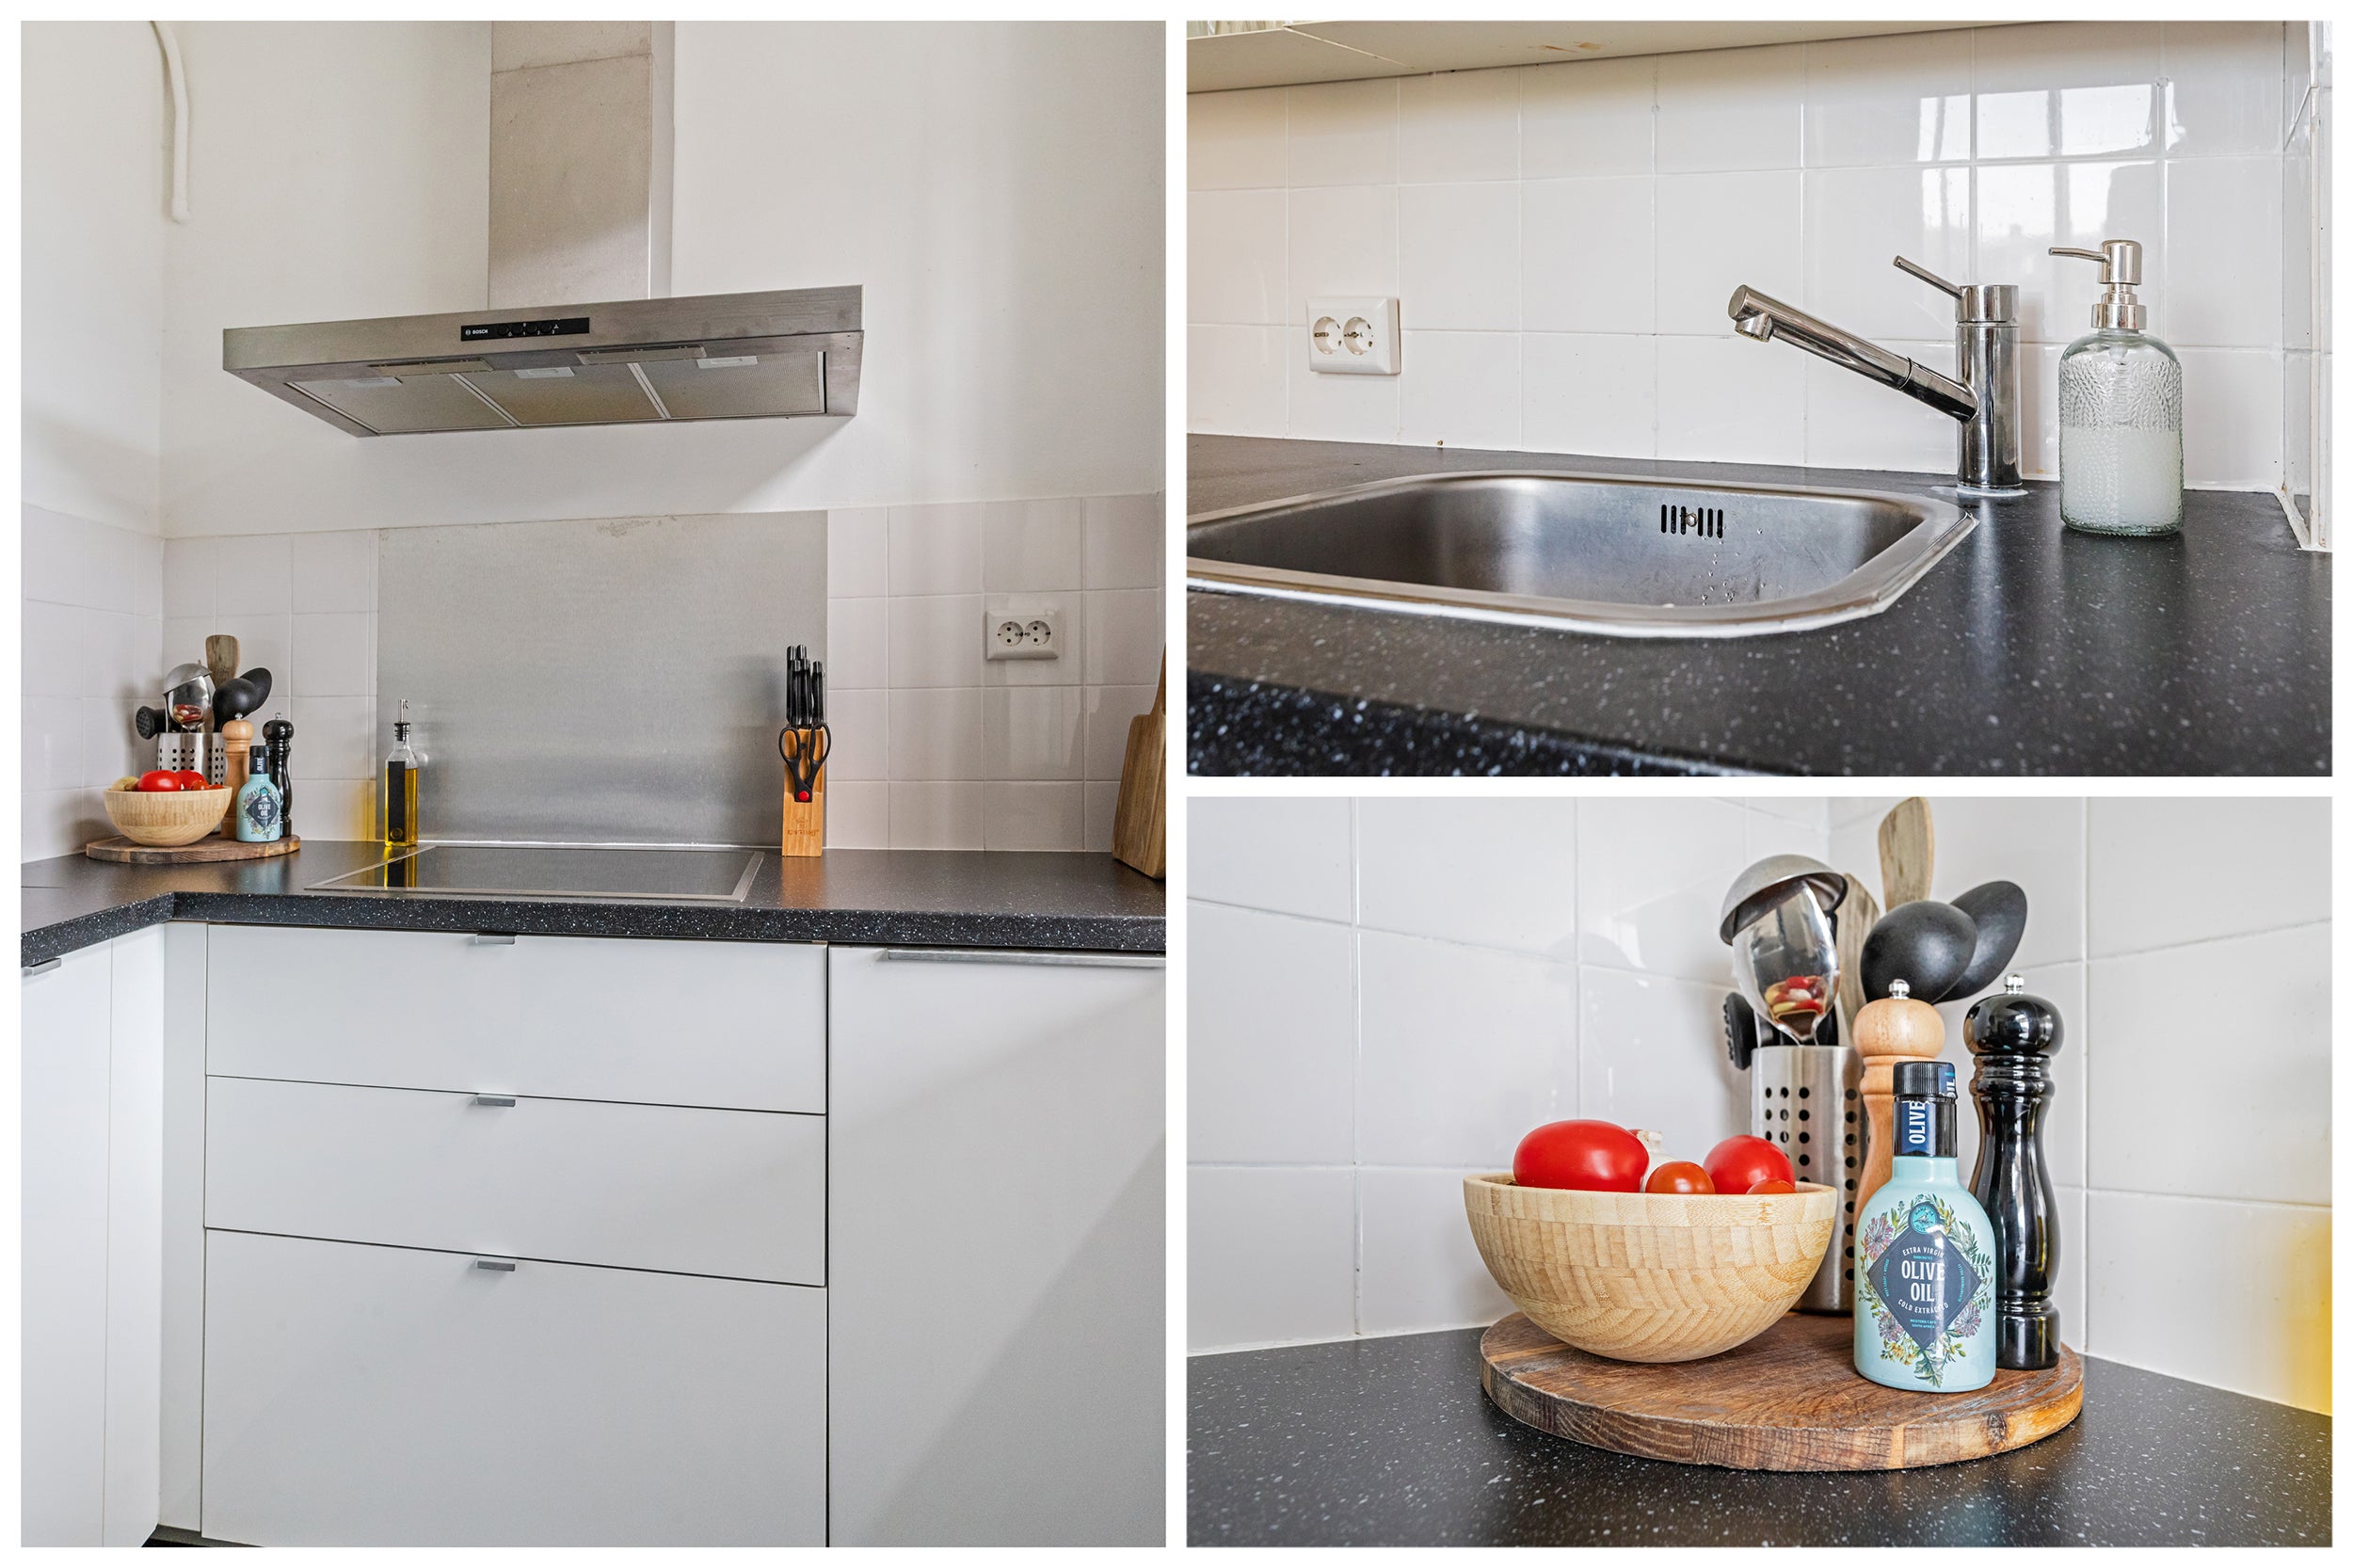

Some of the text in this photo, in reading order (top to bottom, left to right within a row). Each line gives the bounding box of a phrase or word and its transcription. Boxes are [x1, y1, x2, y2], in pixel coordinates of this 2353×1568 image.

[1909, 1100, 1926, 1144] OLIVE
[1902, 1246, 1945, 1258] EXTRA VIRGIN
[1901, 1259, 1945, 1281] OLIVE
[1911, 1282, 1936, 1303] OIL
[1897, 1299, 1949, 1315] COLD EXTRACD
